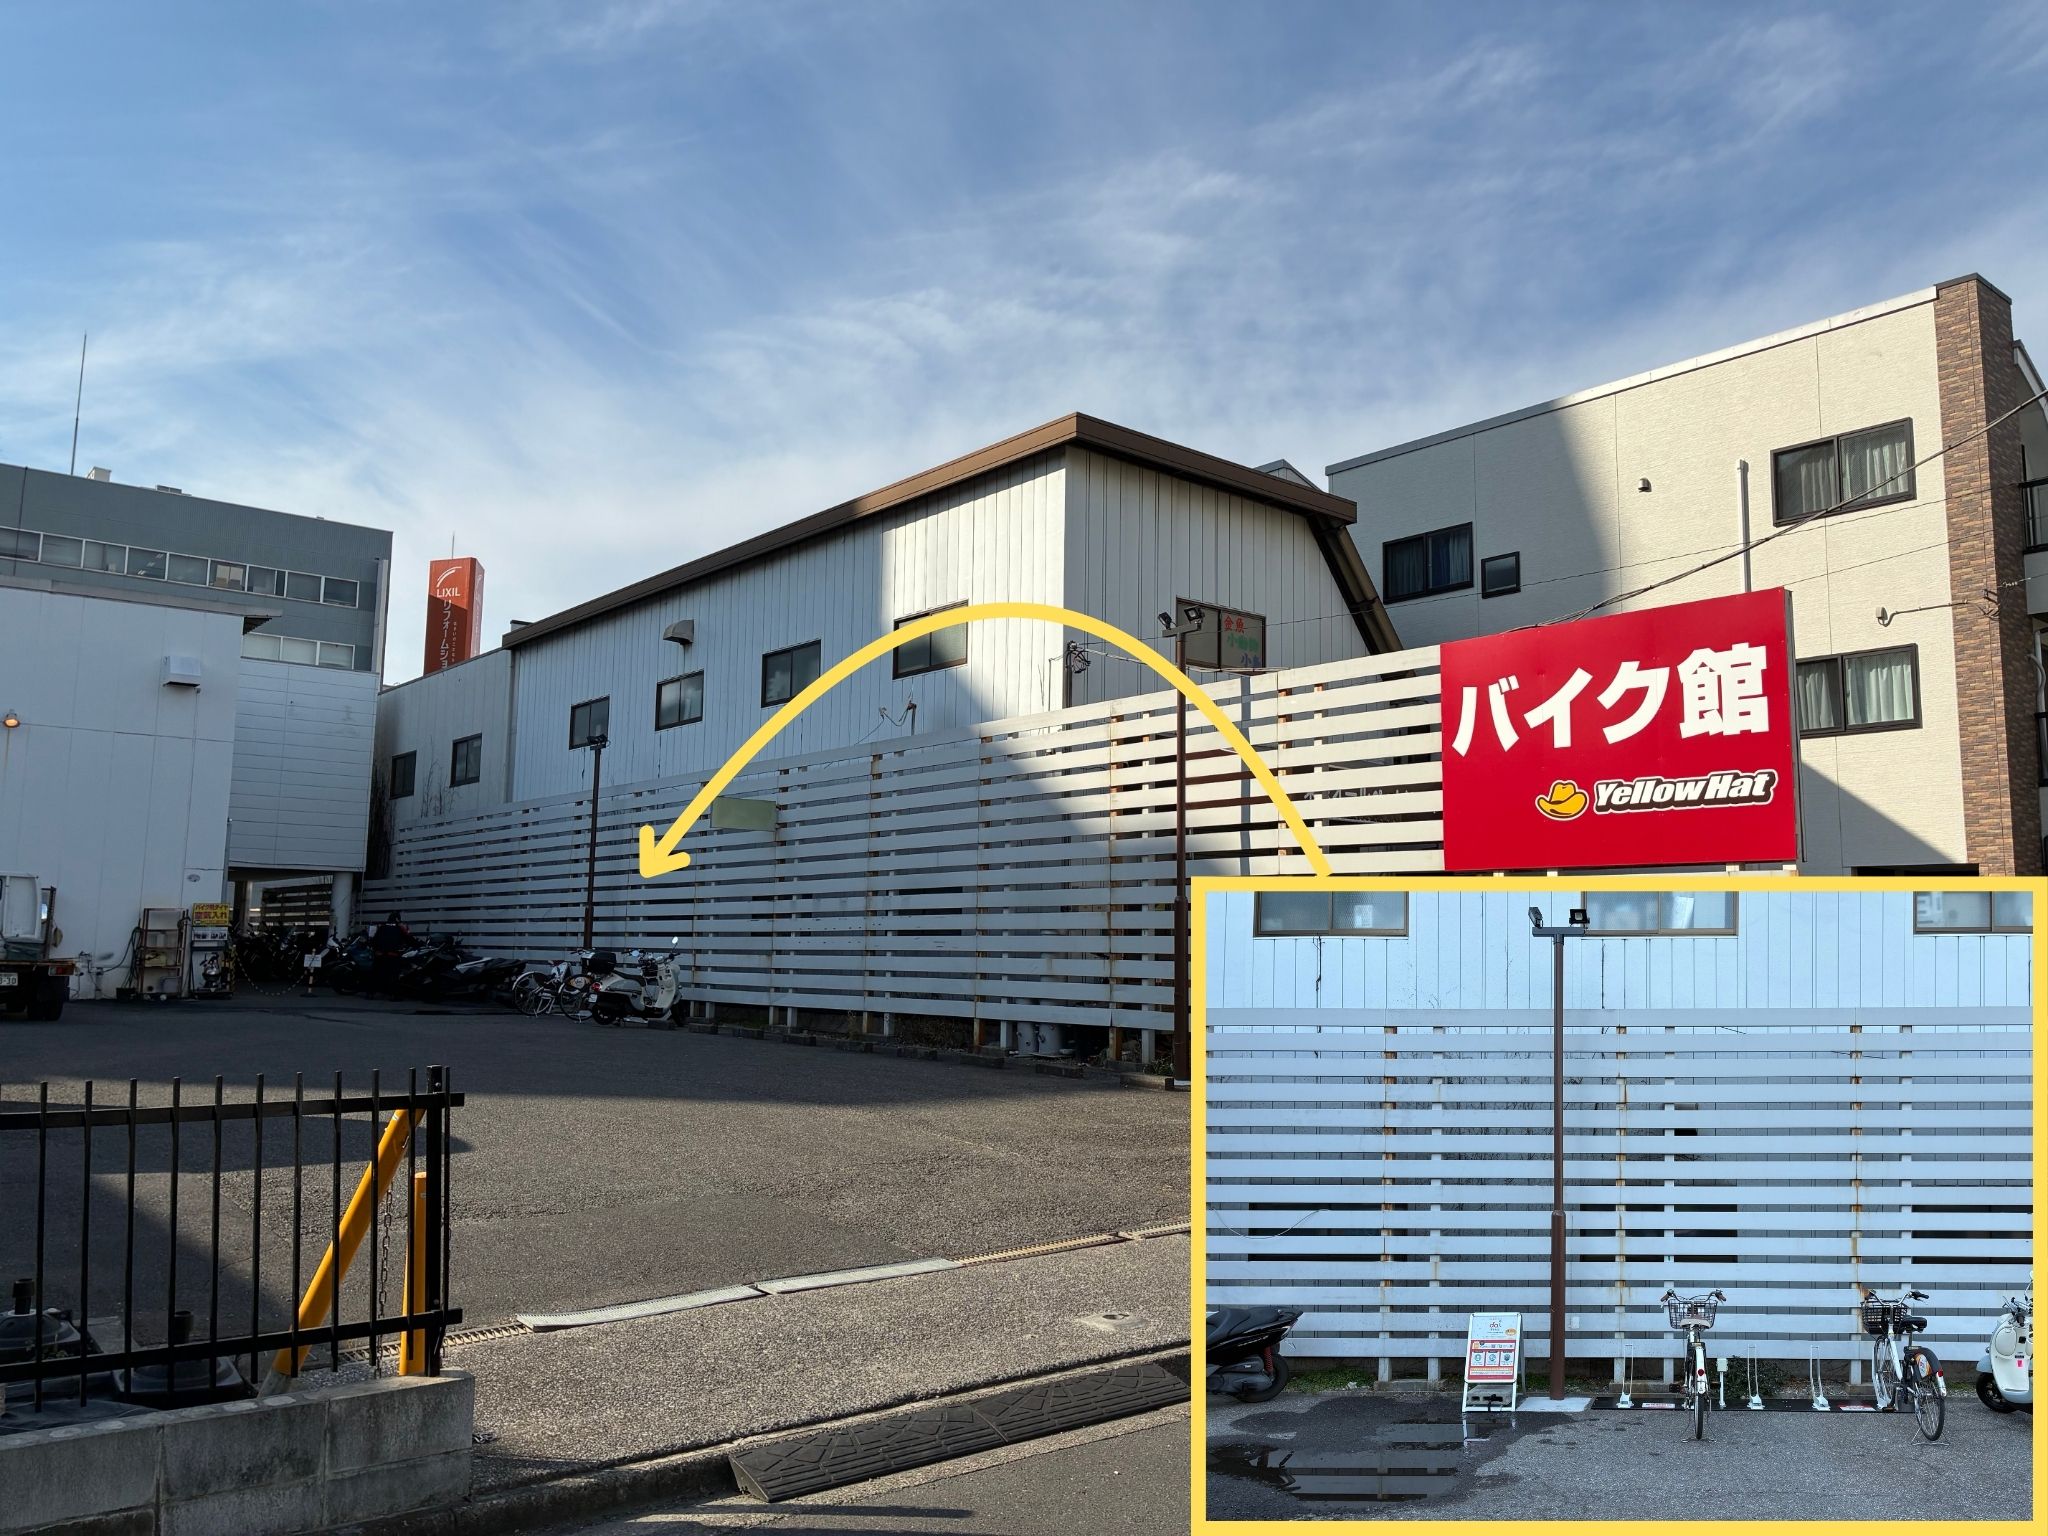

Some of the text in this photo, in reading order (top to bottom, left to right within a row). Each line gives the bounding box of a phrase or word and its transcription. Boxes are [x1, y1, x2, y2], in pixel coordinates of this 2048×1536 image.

[436, 586, 461, 598] LIXIL
[1223, 614, 1245, 634] 金魚
[1452, 642, 1769, 757] バイク館
